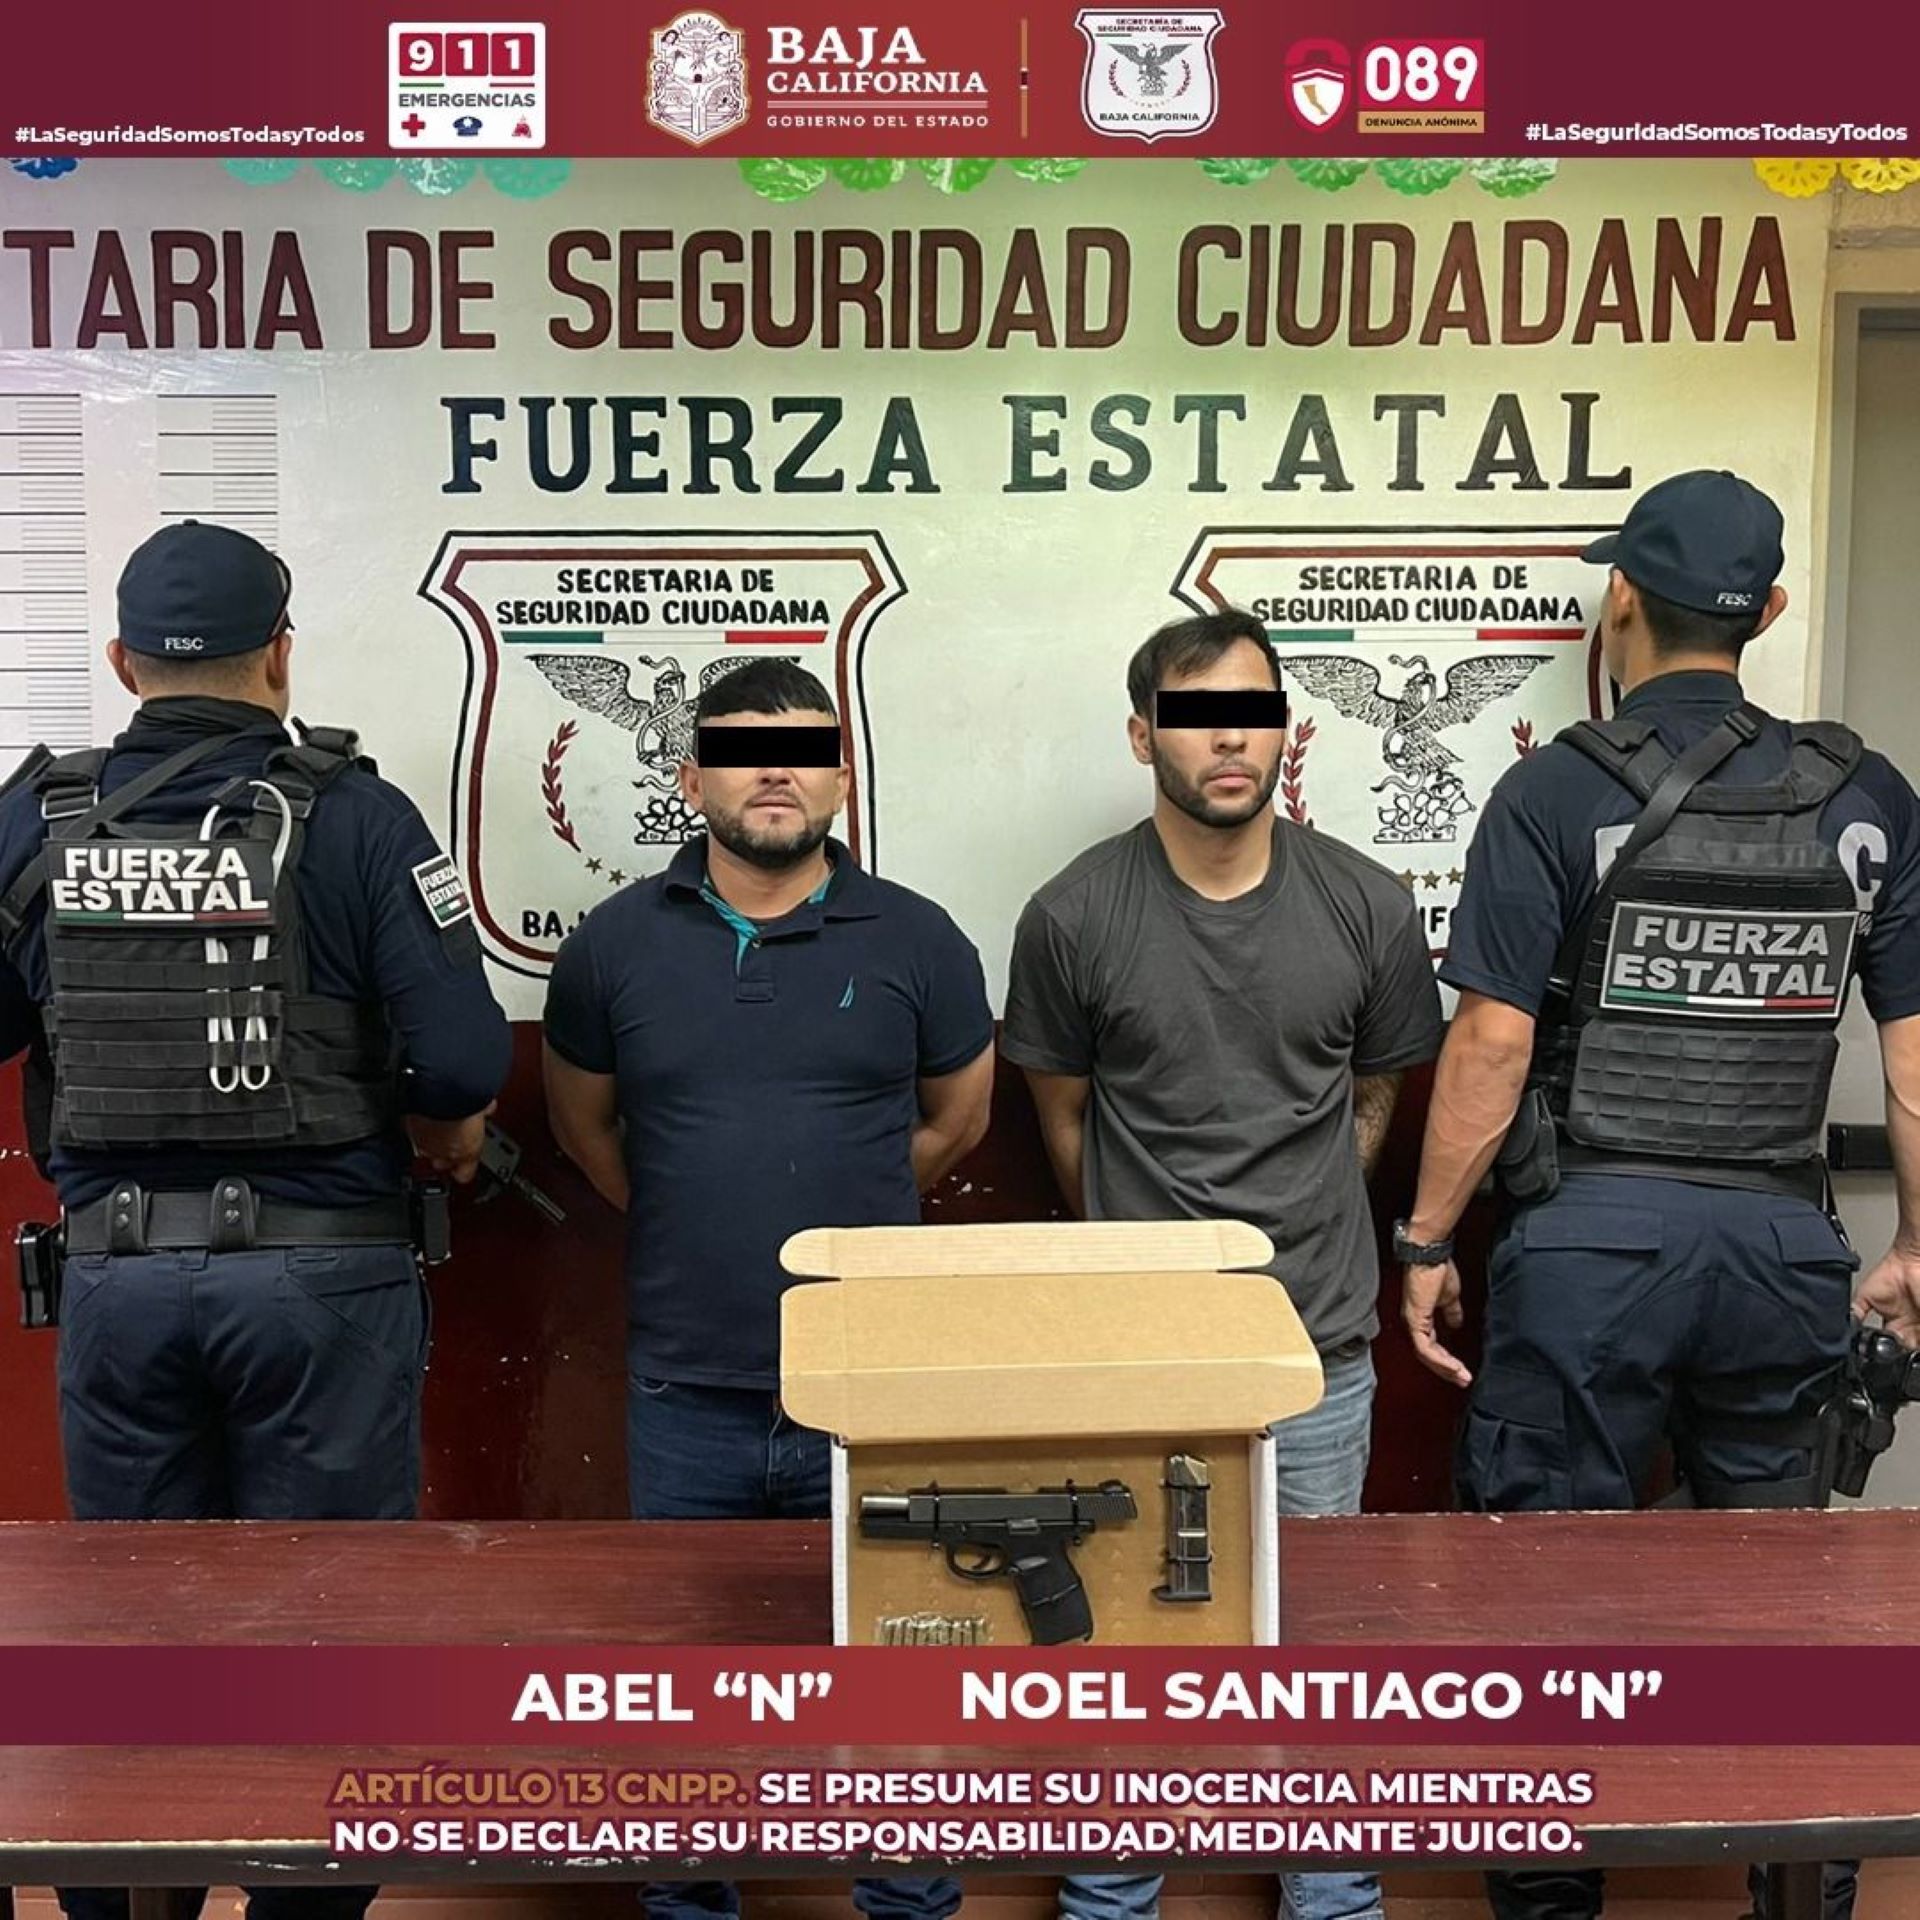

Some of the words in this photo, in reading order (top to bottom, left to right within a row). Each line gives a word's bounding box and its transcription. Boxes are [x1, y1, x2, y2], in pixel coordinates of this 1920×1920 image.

[3, 231, 323, 350] TARIA
[367, 231, 495, 349] DE
[549, 227, 1130, 350] SEGURIDAD
[1178, 217, 1795, 346] CIUDADANA
[441, 396, 940, 493] FUERZA
[1002, 393, 1632, 493] ESTATAL
[558, 569, 732, 593] SECRETARIA
[742, 569, 774, 592] DE
[1299, 566, 1477, 591] SECRETARIA
[1494, 566, 1528, 589] DE
[497, 600, 649, 625] SEGURIDAD
[662, 600, 830, 625] CIUDADANA
[1252, 598, 1409, 622] SEGURIDAD
[1416, 597, 1584, 622] CIUDADANA
[1716, 592, 1752, 606] FESC
[165, 637, 204, 651] FESC
[65, 847, 248, 879] FUERZA
[52, 880, 269, 911] ESTATAL
[1632, 916, 1829, 956] FUERZA
[1612, 954, 1836, 996] ESTATAL
